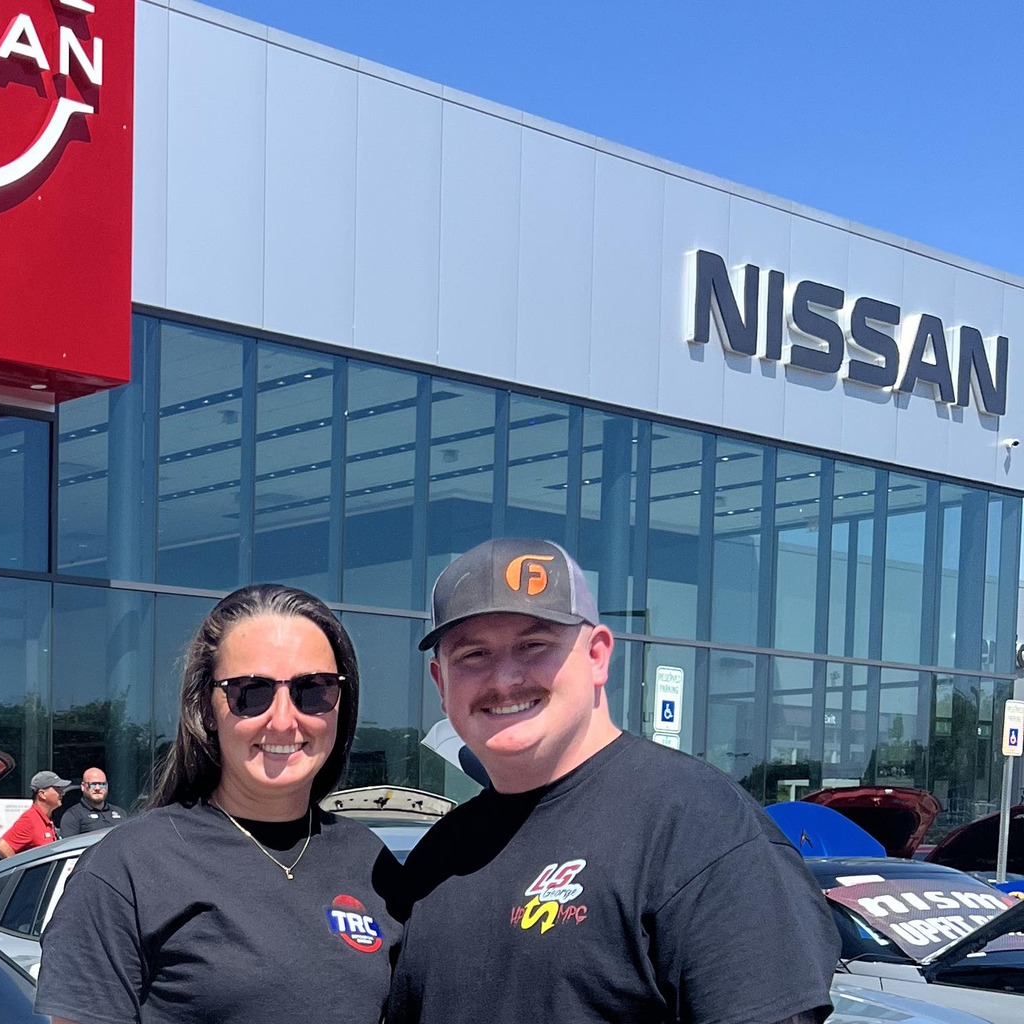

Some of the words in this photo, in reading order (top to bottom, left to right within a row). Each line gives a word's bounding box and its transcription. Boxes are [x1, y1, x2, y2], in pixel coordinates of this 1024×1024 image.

[694, 250, 1009, 415] NISSAN
[543, 888, 578, 899] George
[858, 891, 1014, 917] NISM
[331, 910, 378, 937] TRC
[557, 904, 587, 925] MPG
